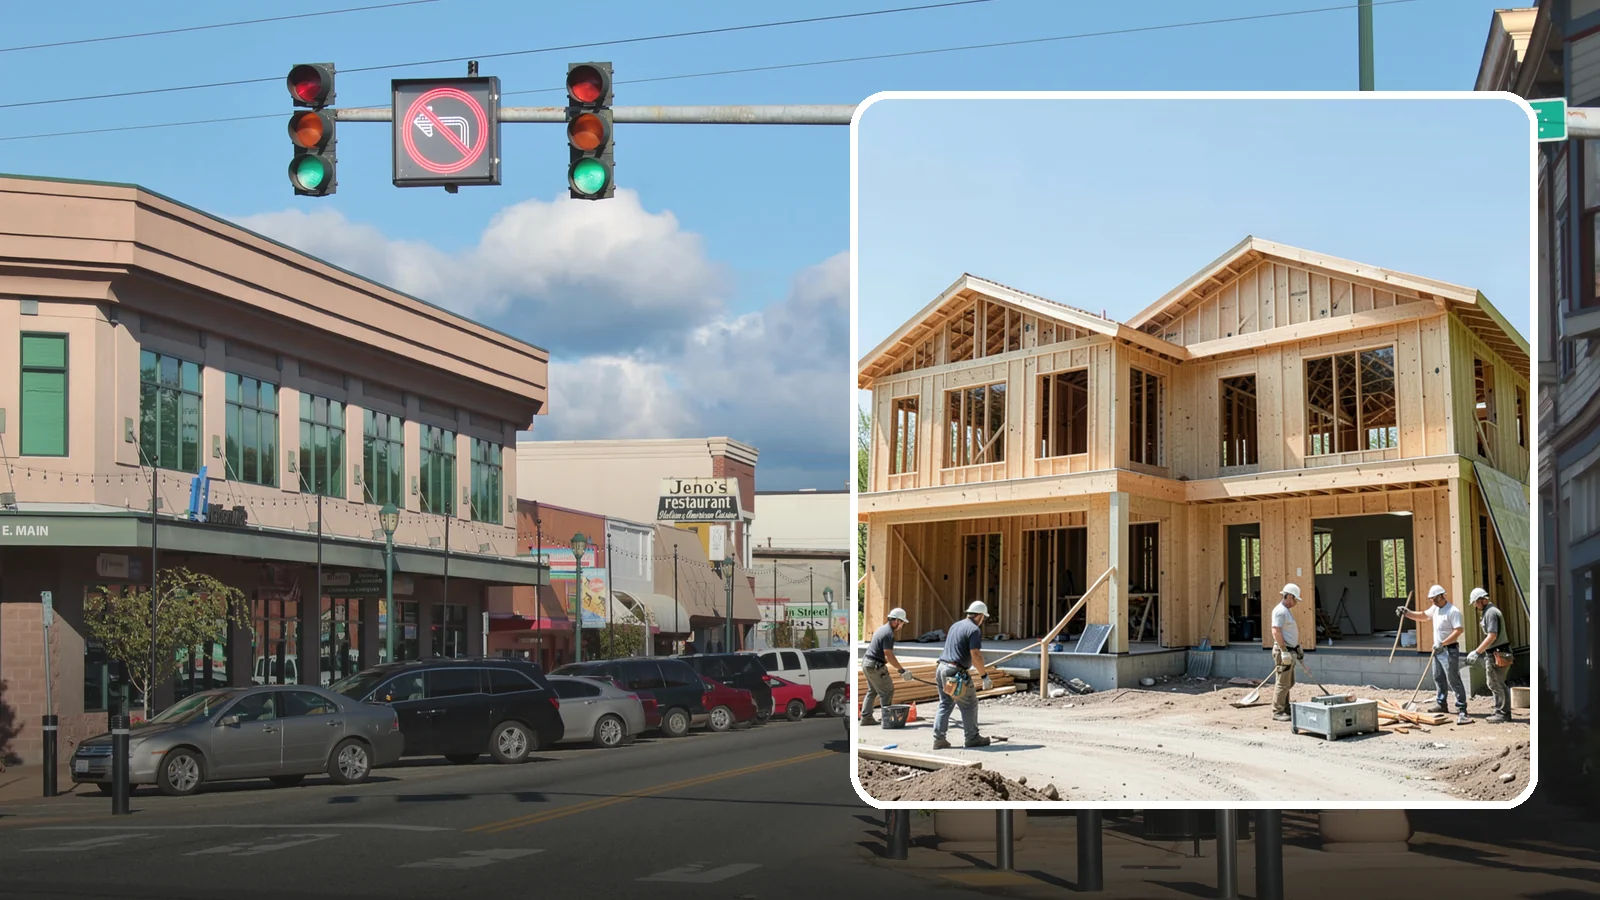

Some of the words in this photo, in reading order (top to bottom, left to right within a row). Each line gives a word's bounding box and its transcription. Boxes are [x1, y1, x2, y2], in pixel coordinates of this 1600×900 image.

[669, 479, 727, 495] Jeno's
[665, 496, 731, 509] restaurant
[658, 509, 681, 519] Italian
[686, 509, 714, 519] American
[715, 509, 738, 519] Cuisine
[2, 525, 13, 536] E.
[15, 525, 49, 536] MAIN
[797, 607, 828, 617] Street
